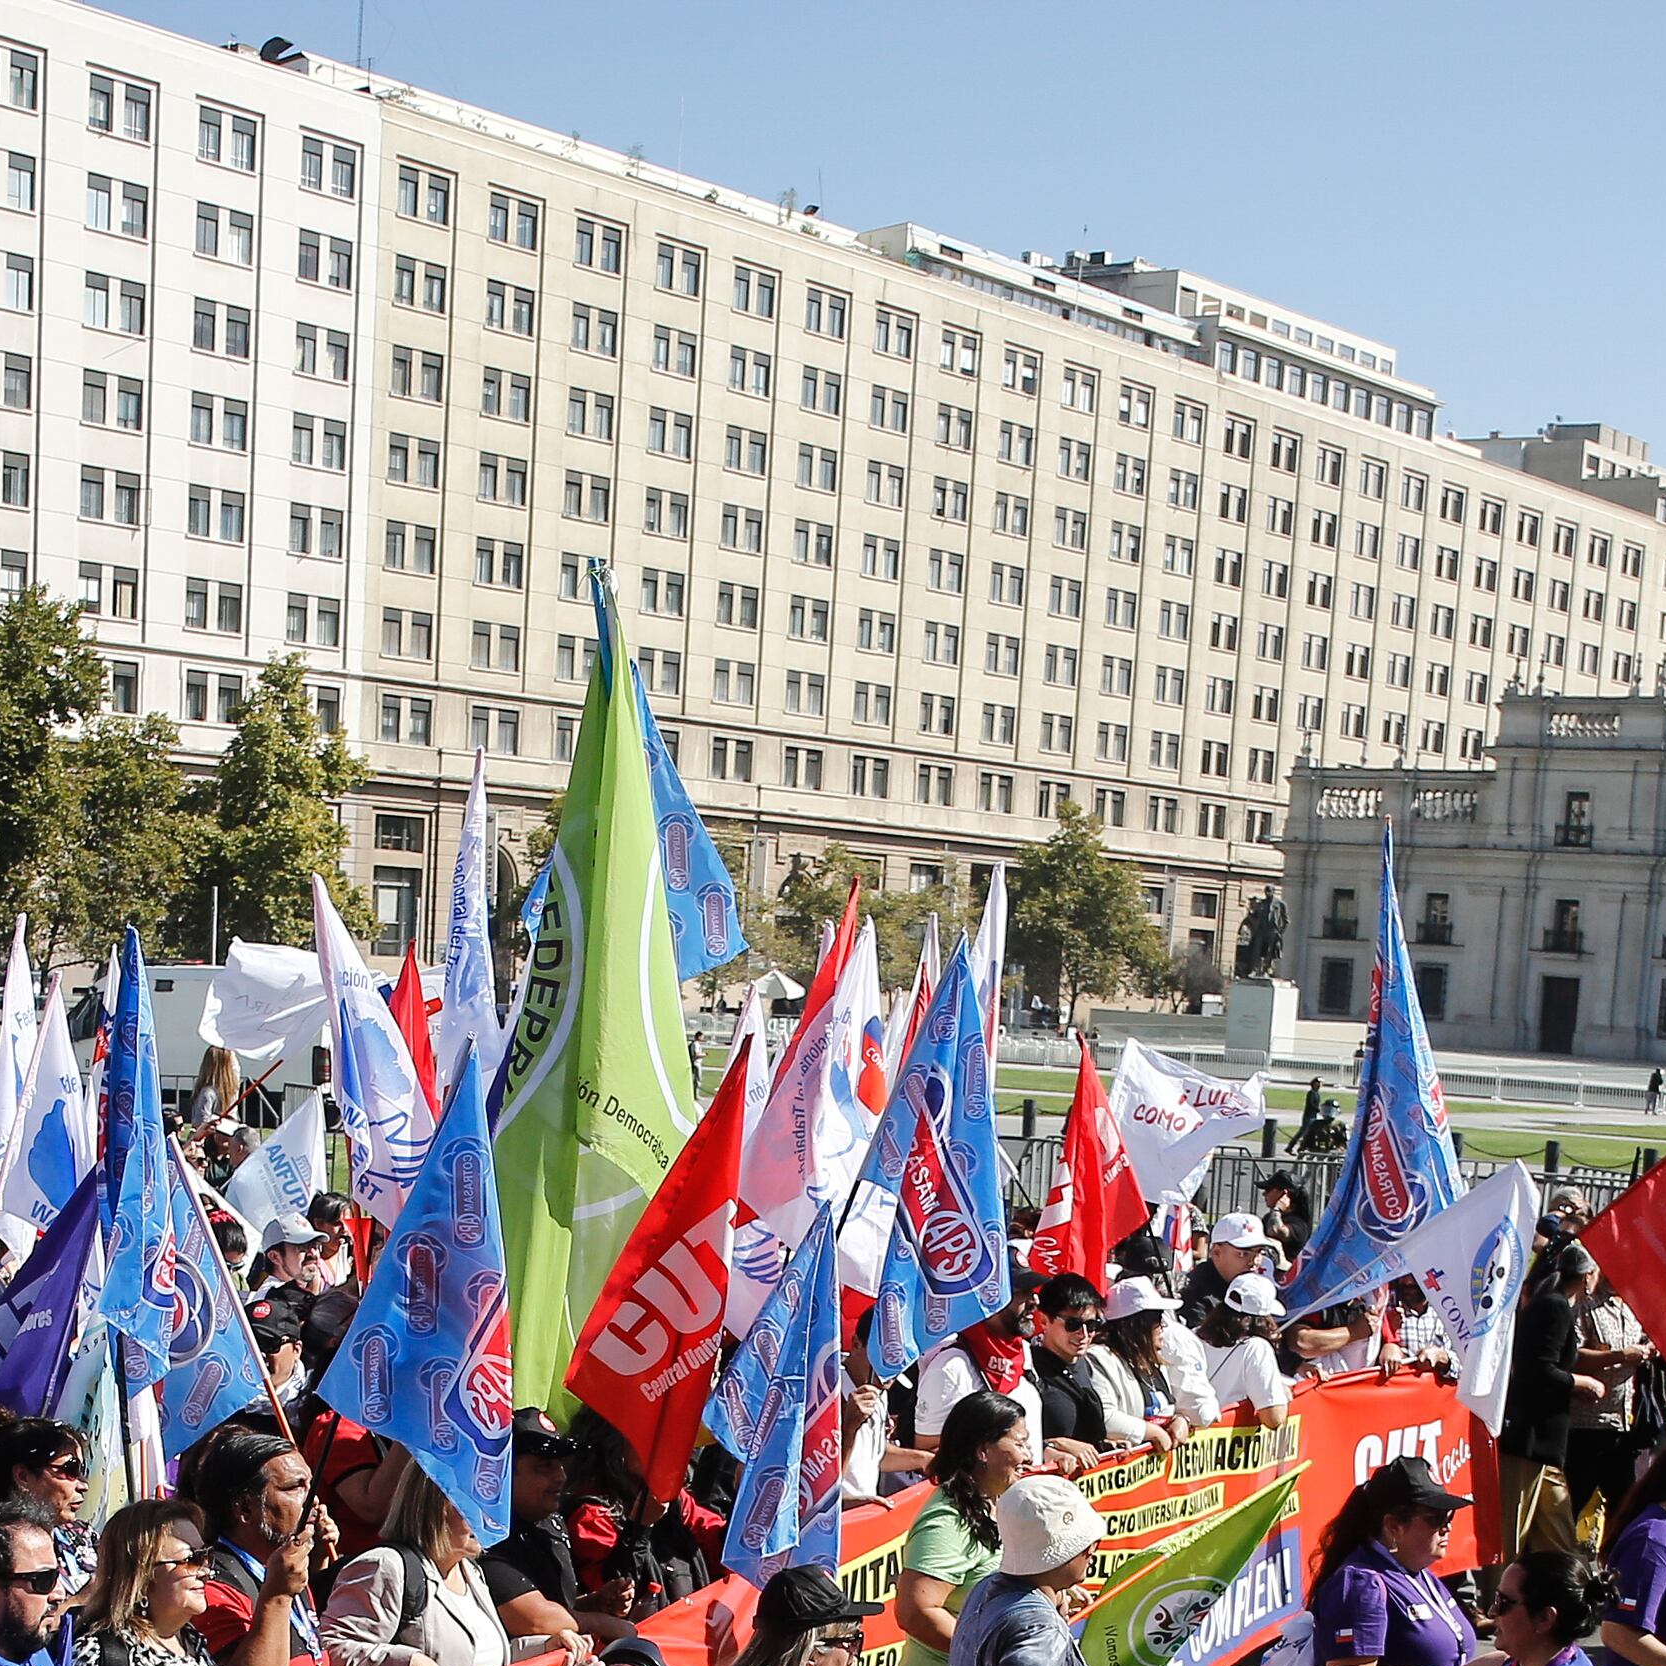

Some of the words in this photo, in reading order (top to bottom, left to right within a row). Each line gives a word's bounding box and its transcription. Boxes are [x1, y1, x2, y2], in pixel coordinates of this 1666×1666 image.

[506, 867, 564, 1093] FEDEPR
[1133, 1103, 1186, 1132] COMO
[928, 1211, 981, 1287] APS
[589, 1199, 737, 1376] CUT
[639, 1362, 689, 1403] Central
[685, 1330, 724, 1371] Unita
[1354, 1419, 1442, 1486] CUT
[1441, 1436, 1472, 1485] Chile
[842, 1545, 905, 1607] VITA
[1188, 1547, 1292, 1663] MPLEN!
